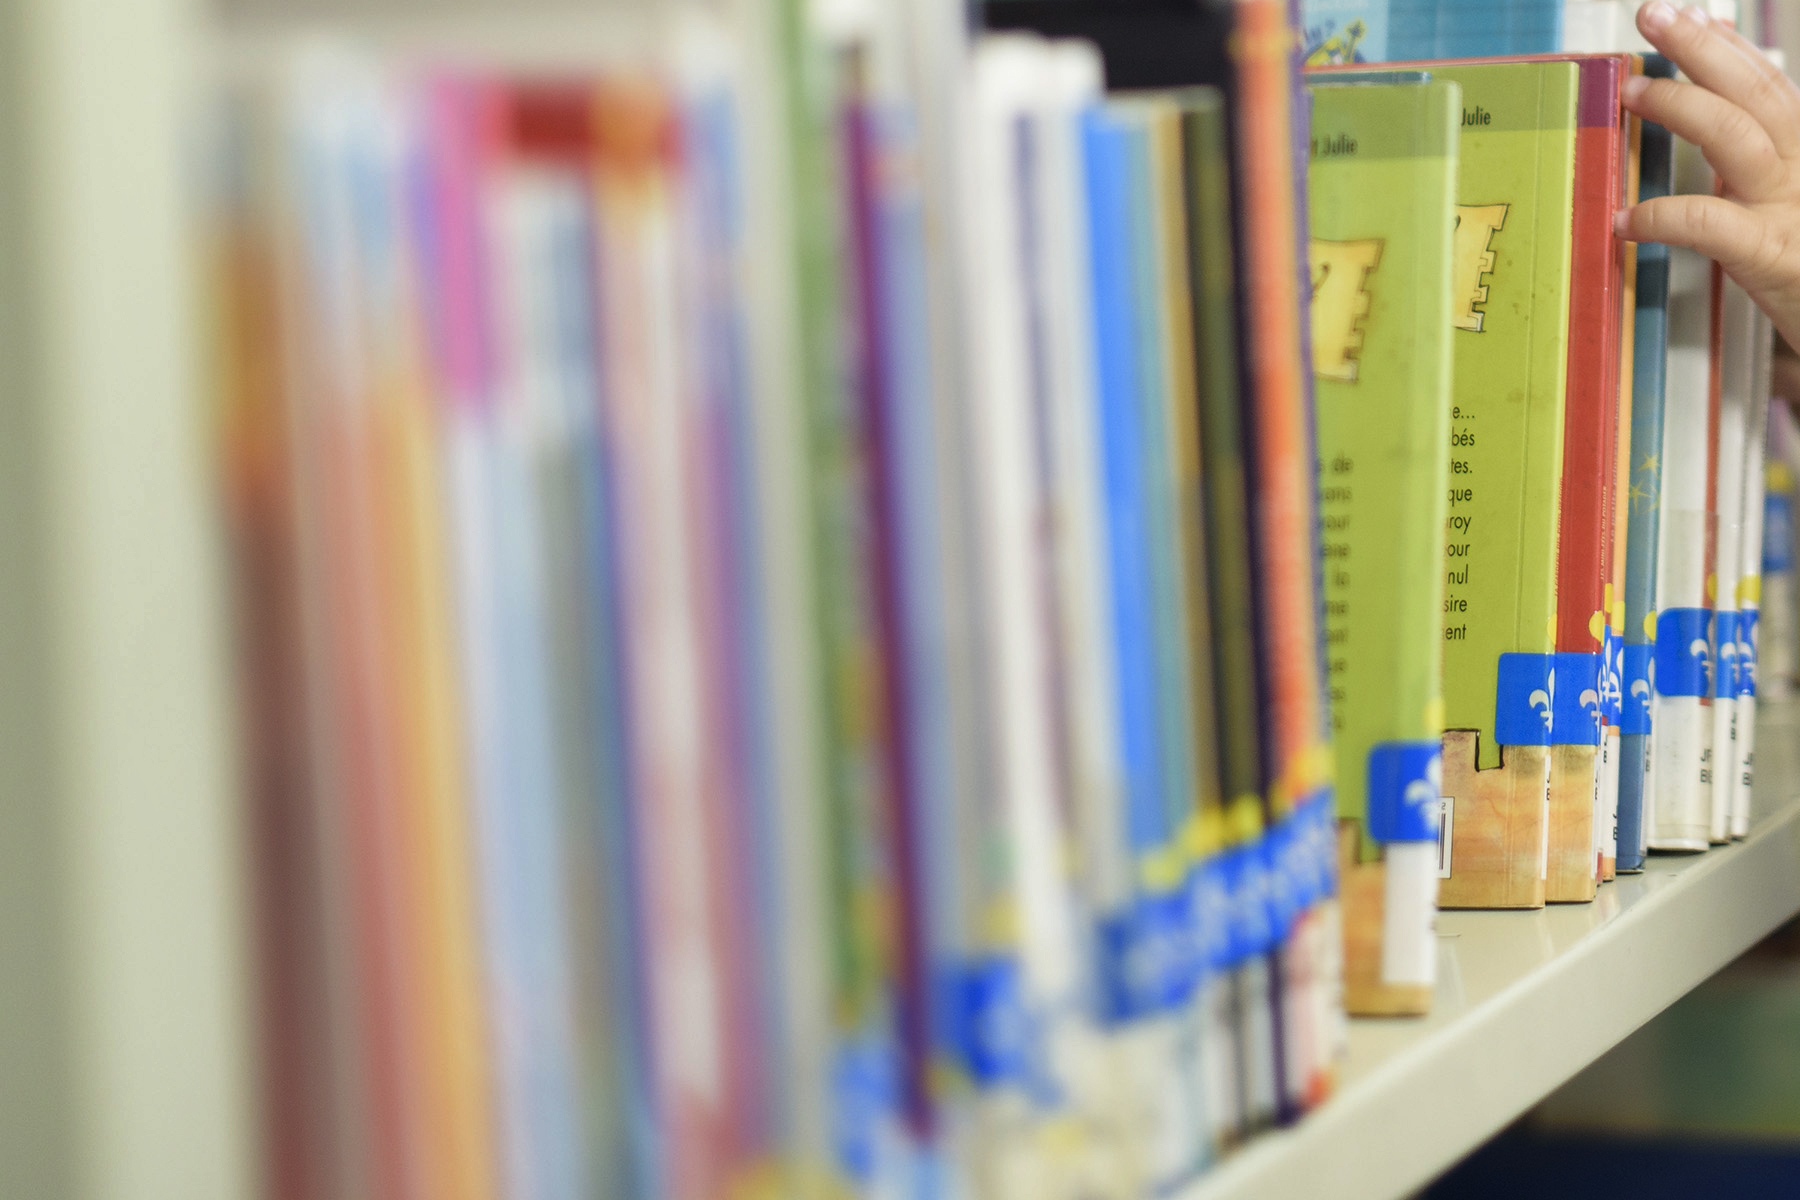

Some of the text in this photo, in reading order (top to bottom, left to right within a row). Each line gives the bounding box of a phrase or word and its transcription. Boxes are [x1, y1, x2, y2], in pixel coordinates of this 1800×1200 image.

[1461, 106, 1492, 127] Julie
[1452, 406, 1475, 419] e...
[1451, 426, 1475, 447] bés
[1450, 458, 1473, 474] tes.
[1446, 516, 1472, 535] roy
[1446, 543, 1471, 557] our
[1444, 623, 1467, 640] ent
